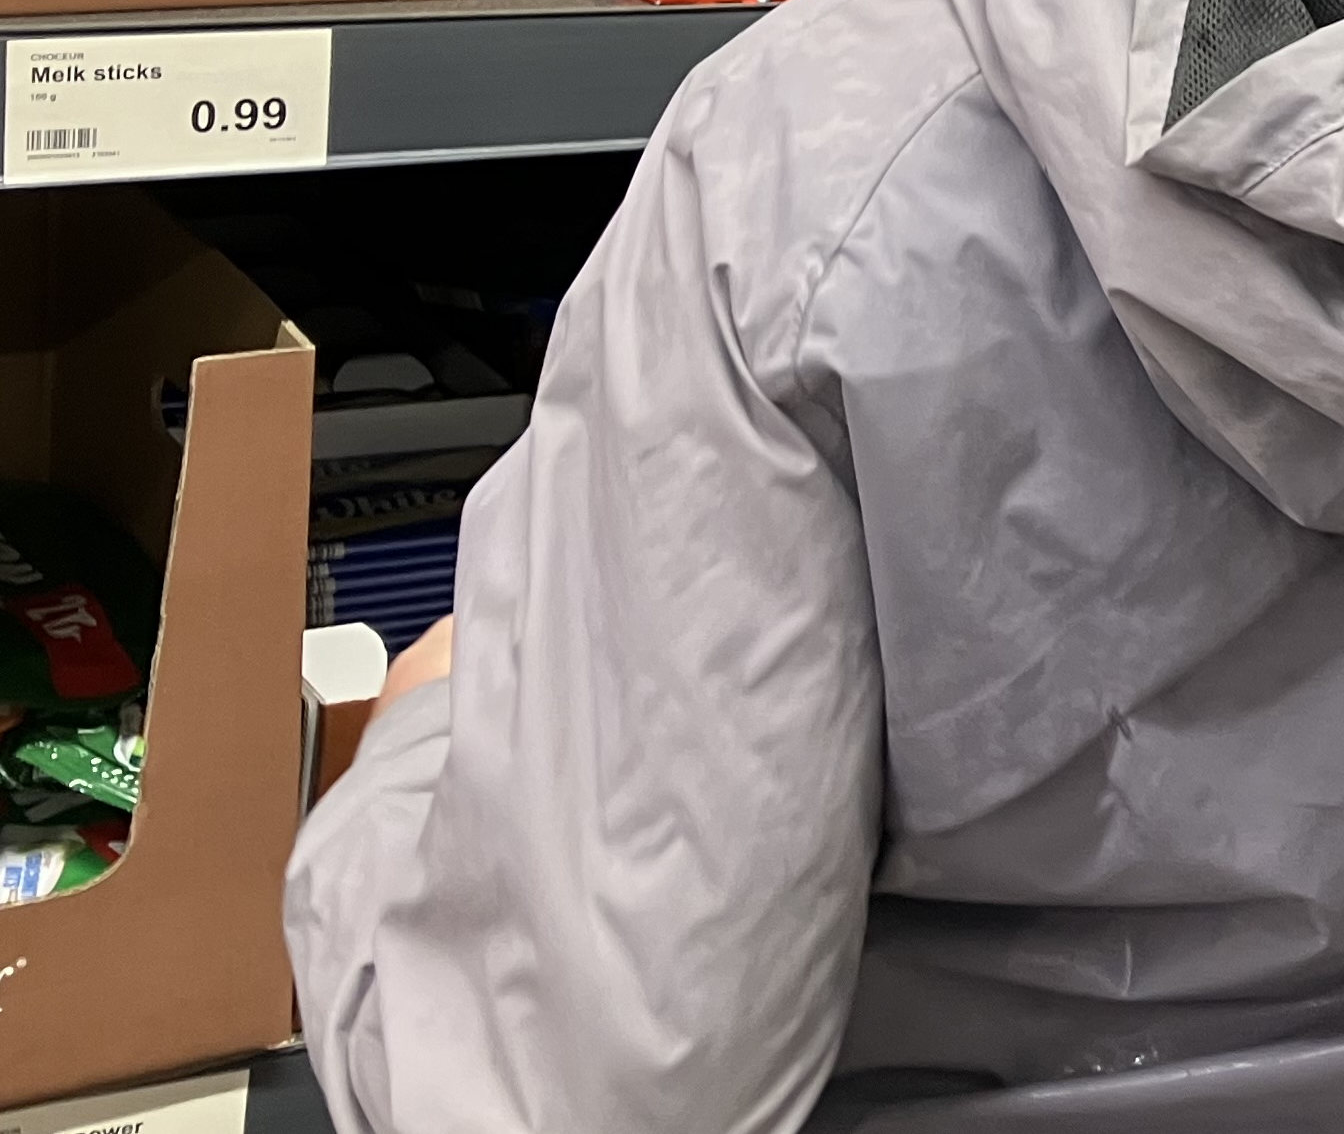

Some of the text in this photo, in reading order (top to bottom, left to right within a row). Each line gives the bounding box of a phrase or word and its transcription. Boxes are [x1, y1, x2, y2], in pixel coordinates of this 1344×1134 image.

[30, 53, 84, 61] CHOCEUR
[31, 63, 162, 83] Melk sticks
[191, 97, 287, 133] 0.99
